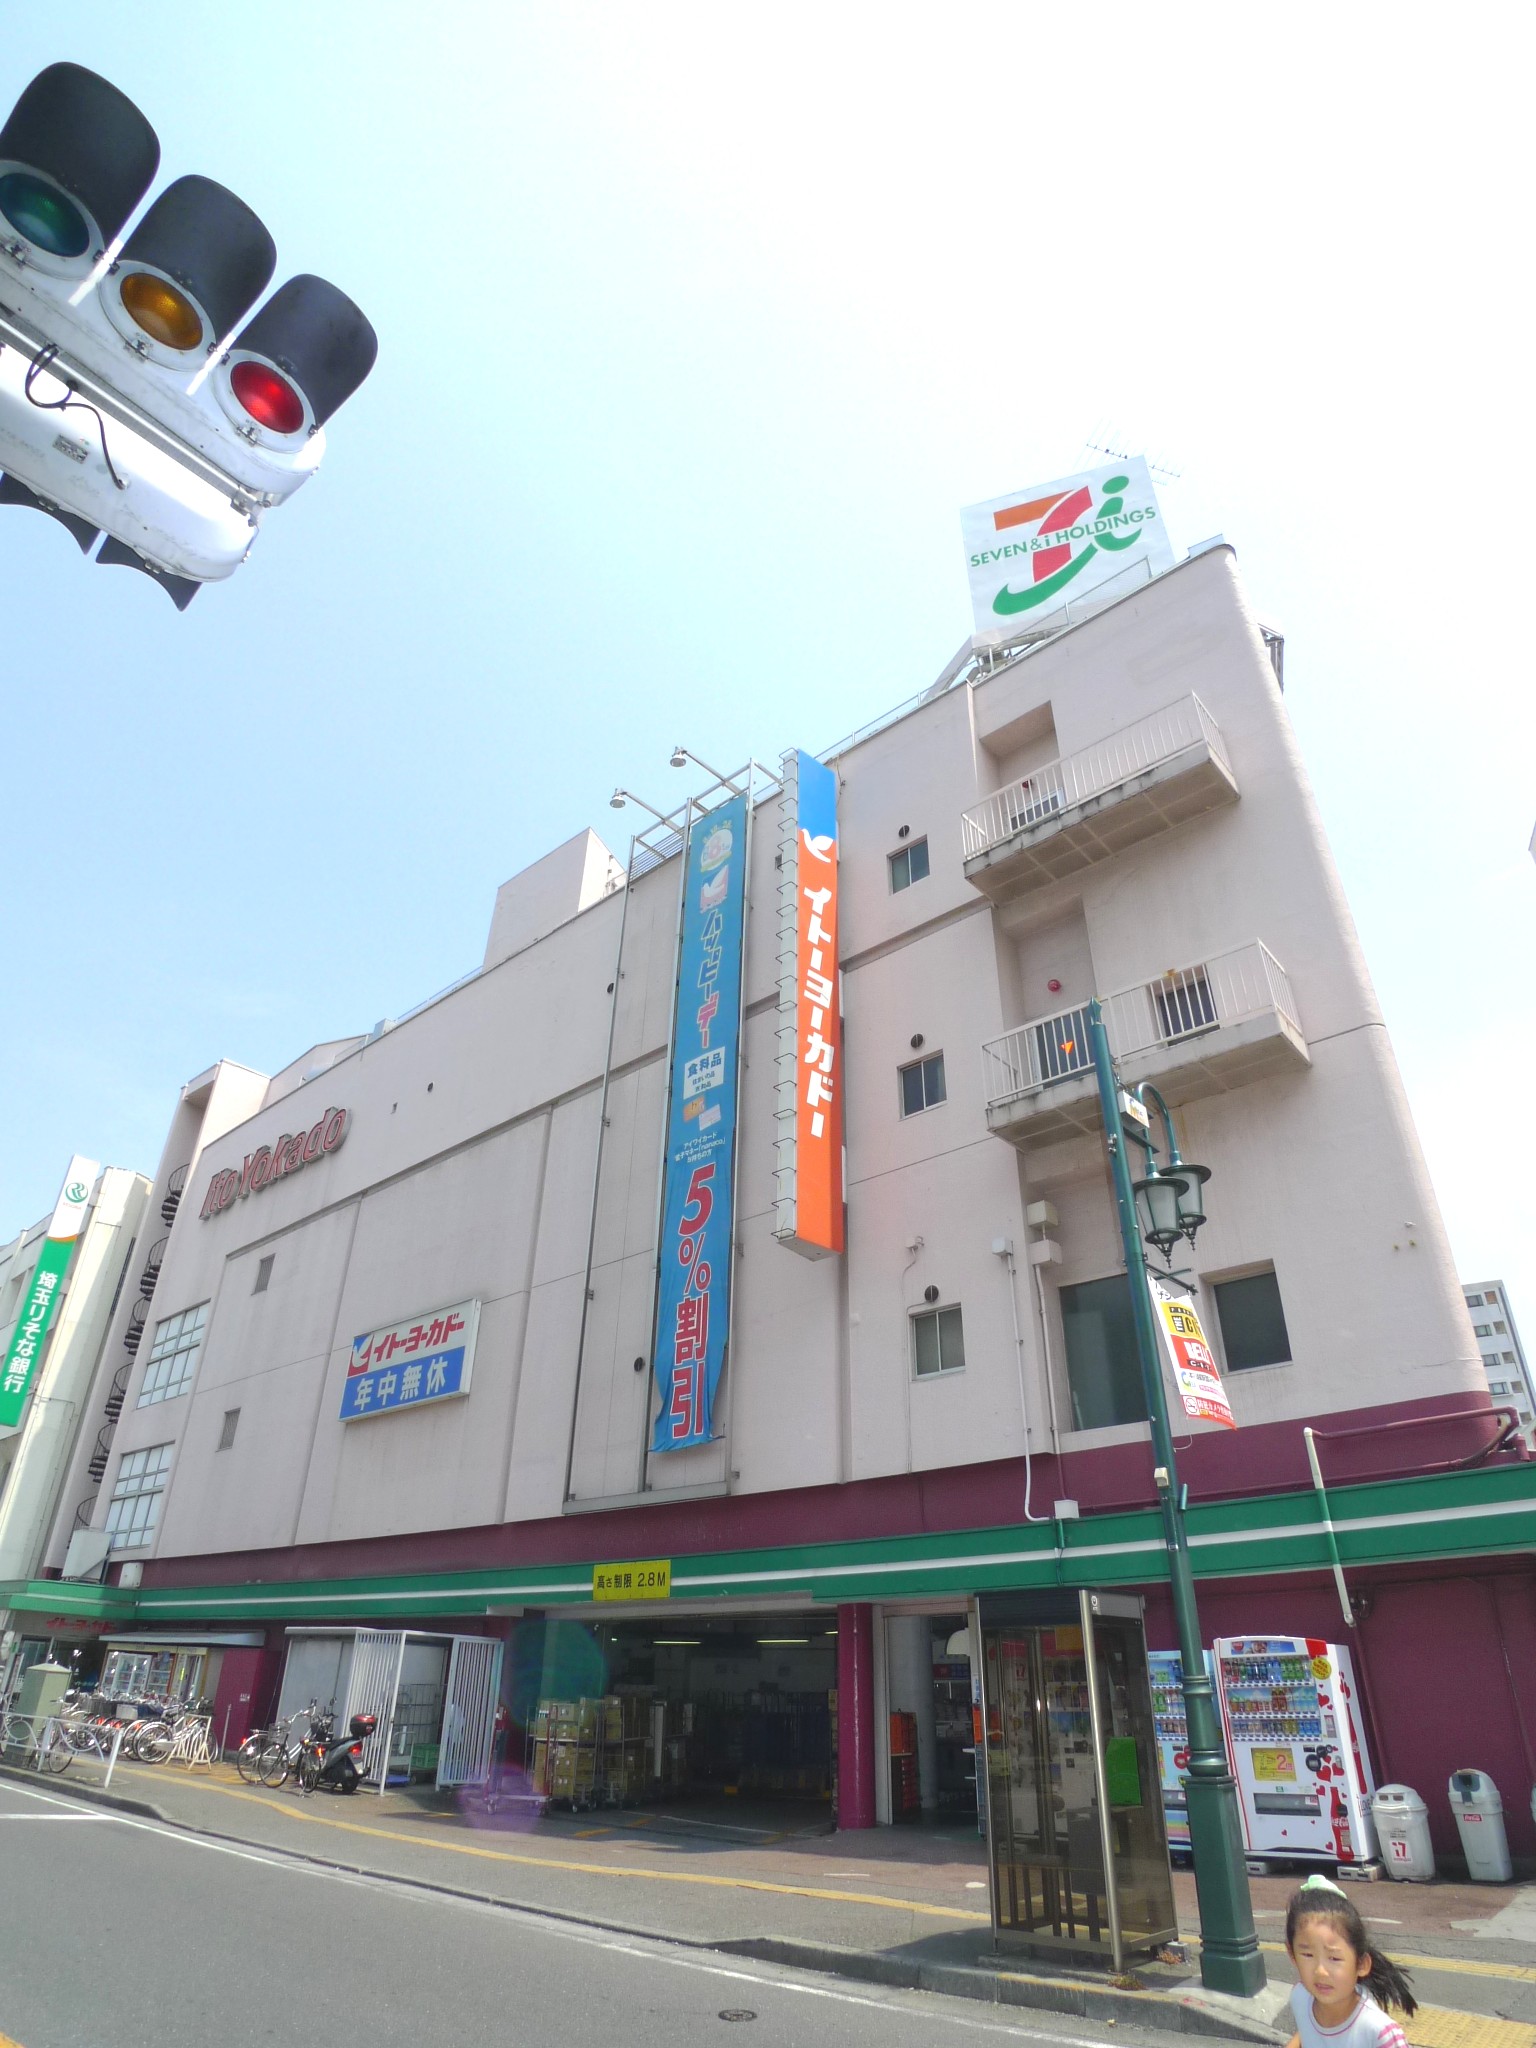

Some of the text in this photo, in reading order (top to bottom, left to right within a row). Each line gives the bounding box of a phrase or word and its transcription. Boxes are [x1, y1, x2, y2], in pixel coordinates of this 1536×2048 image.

[1056, 506, 1156, 545] HOLDINGS
[697, 908, 723, 1049] ハッピーデー
[803, 886, 836, 1139] イトーヨーカドー
[687, 1052, 723, 1079] 食料品
[3, 1269, 58, 1394] 埼玉りそな銀行
[373, 1312, 465, 1363] イトーヨーカドー
[353, 1356, 449, 1411] 年中無休
[596, 1571, 666, 1589] 高さ制限 2.8M
